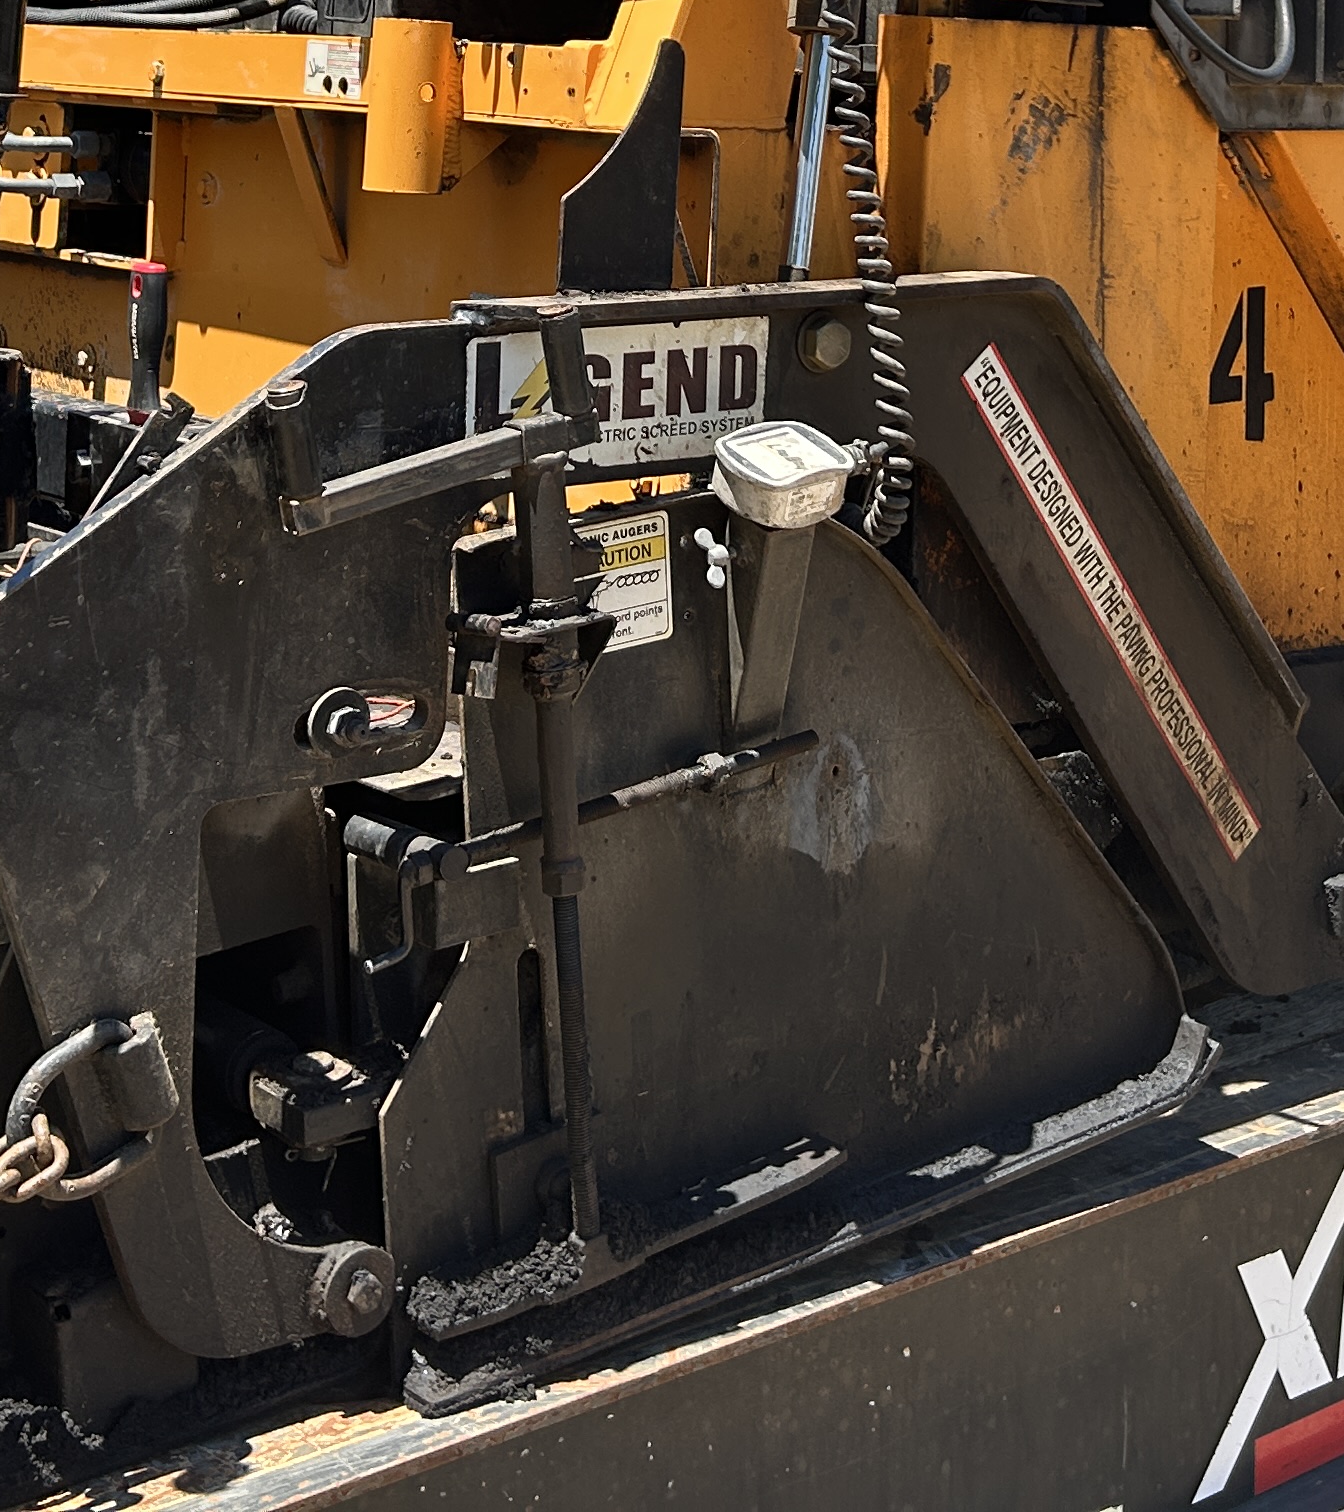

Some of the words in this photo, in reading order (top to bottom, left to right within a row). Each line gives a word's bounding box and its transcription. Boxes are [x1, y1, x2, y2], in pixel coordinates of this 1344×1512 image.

[1209, 286, 1274, 442] 4
[640, 420, 697, 439] SCREED
[701, 415, 755, 434] SYSTEM
[612, 522, 658, 541] AUGERS
[600, 542, 652, 567] UTION
[633, 605, 664, 621] points
[1027, 457, 1085, 549] DESIGNED
[1072, 533, 1109, 592] WITH
[1096, 576, 1127, 624] THE
[1113, 614, 1157, 678] PAVING
[1149, 666, 1219, 791] PROFESSIONAL
[611, 626, 634, 638] ront.
